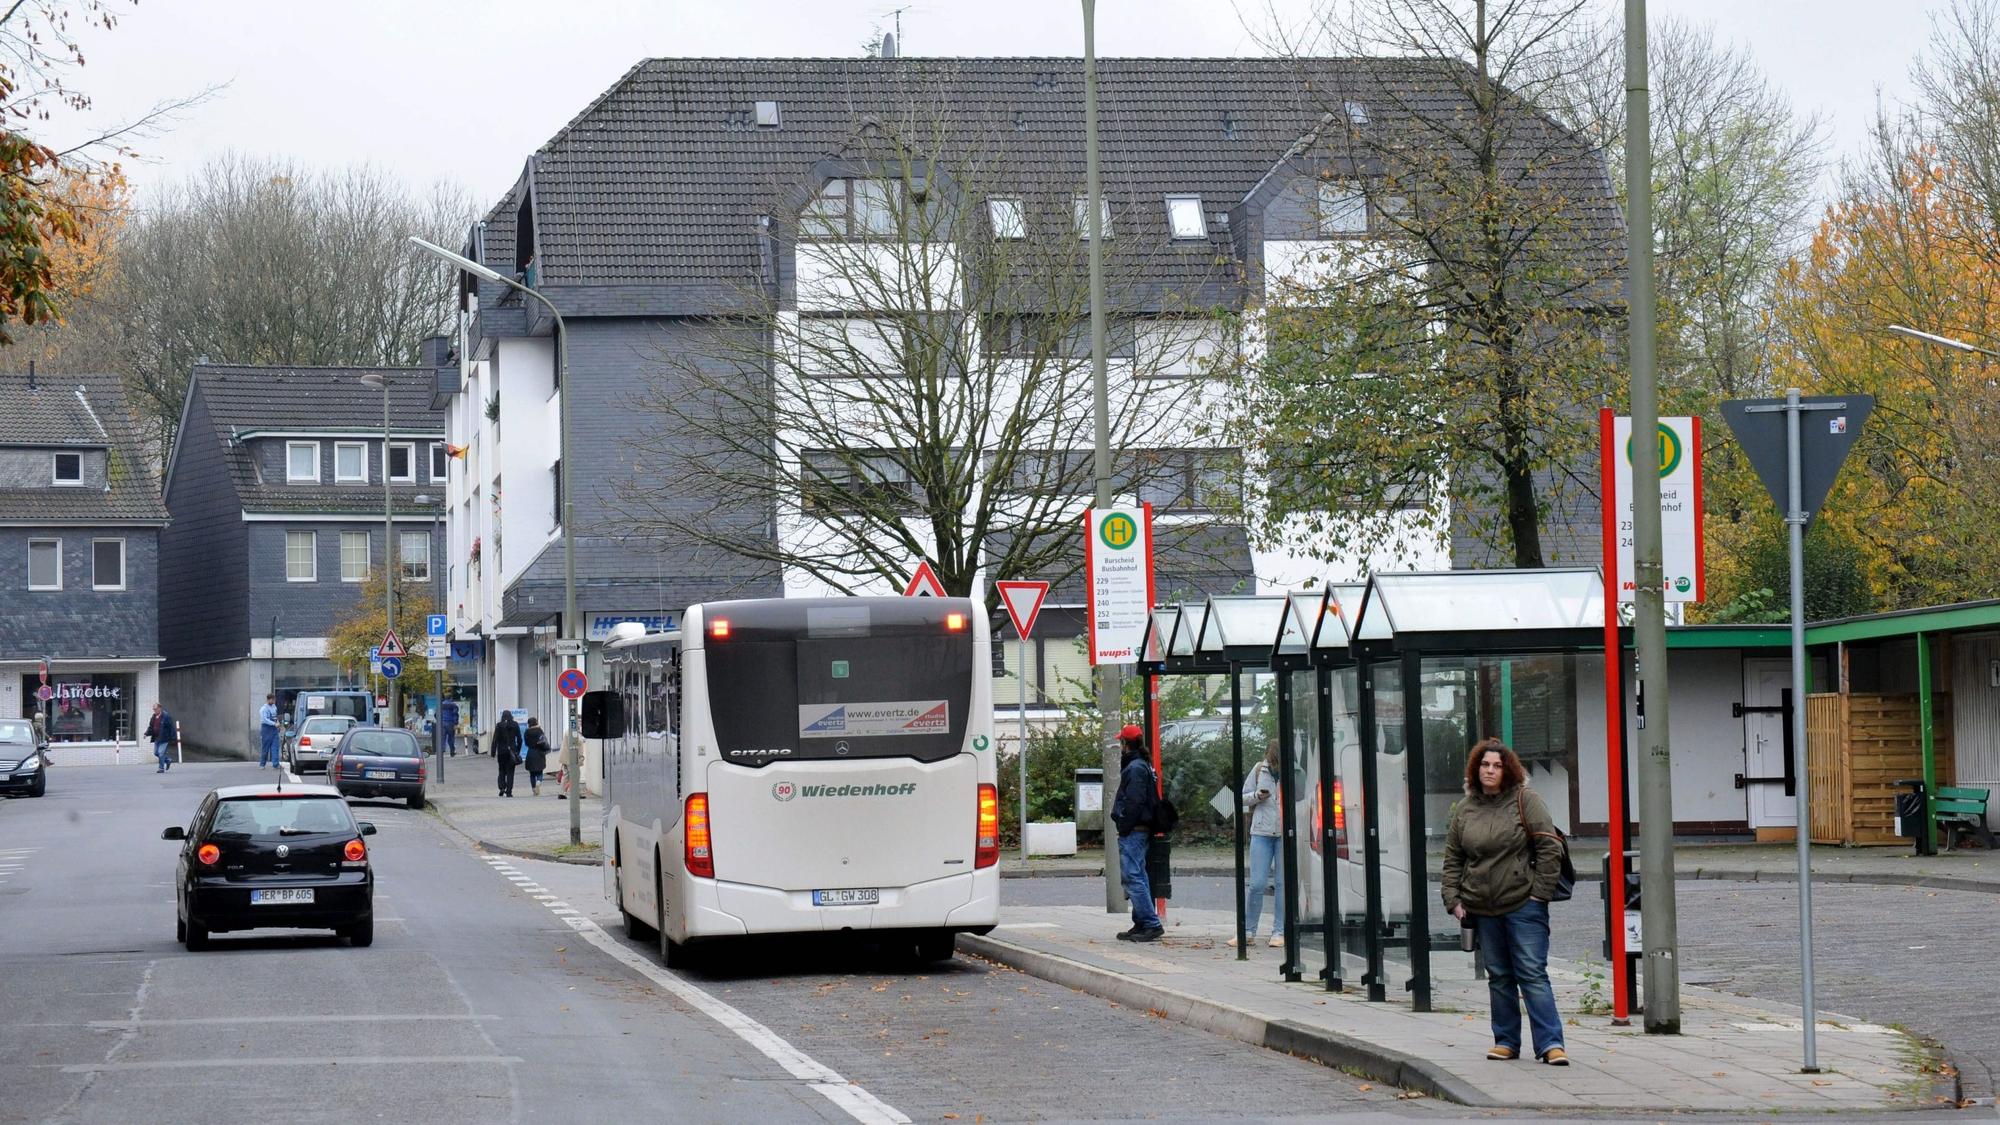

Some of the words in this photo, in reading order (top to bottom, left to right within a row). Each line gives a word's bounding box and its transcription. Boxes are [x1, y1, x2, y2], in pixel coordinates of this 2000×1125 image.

[1621, 522, 1633, 531] 23
[1096, 577, 1109, 585] 229
[1096, 588, 1109, 596] 239
[431, 618, 442, 633] P
[1099, 646, 1131, 658] wupsi
[50, 683, 120, 699] lamotte
[847, 708, 920, 719] www.evertz.de
[817, 719, 845, 727] evertz
[912, 719, 945, 728] evertz
[729, 748, 792, 757] CITARO
[778, 785, 791, 795] 90
[801, 782, 917, 798] Wiedenhoff
[259, 890, 276, 900] HER
[282, 890, 294, 900] BP
[296, 889, 312, 899] 605
[819, 891, 834, 902] GL
[841, 890, 856, 901] GW
[858, 889, 878, 901] 308
